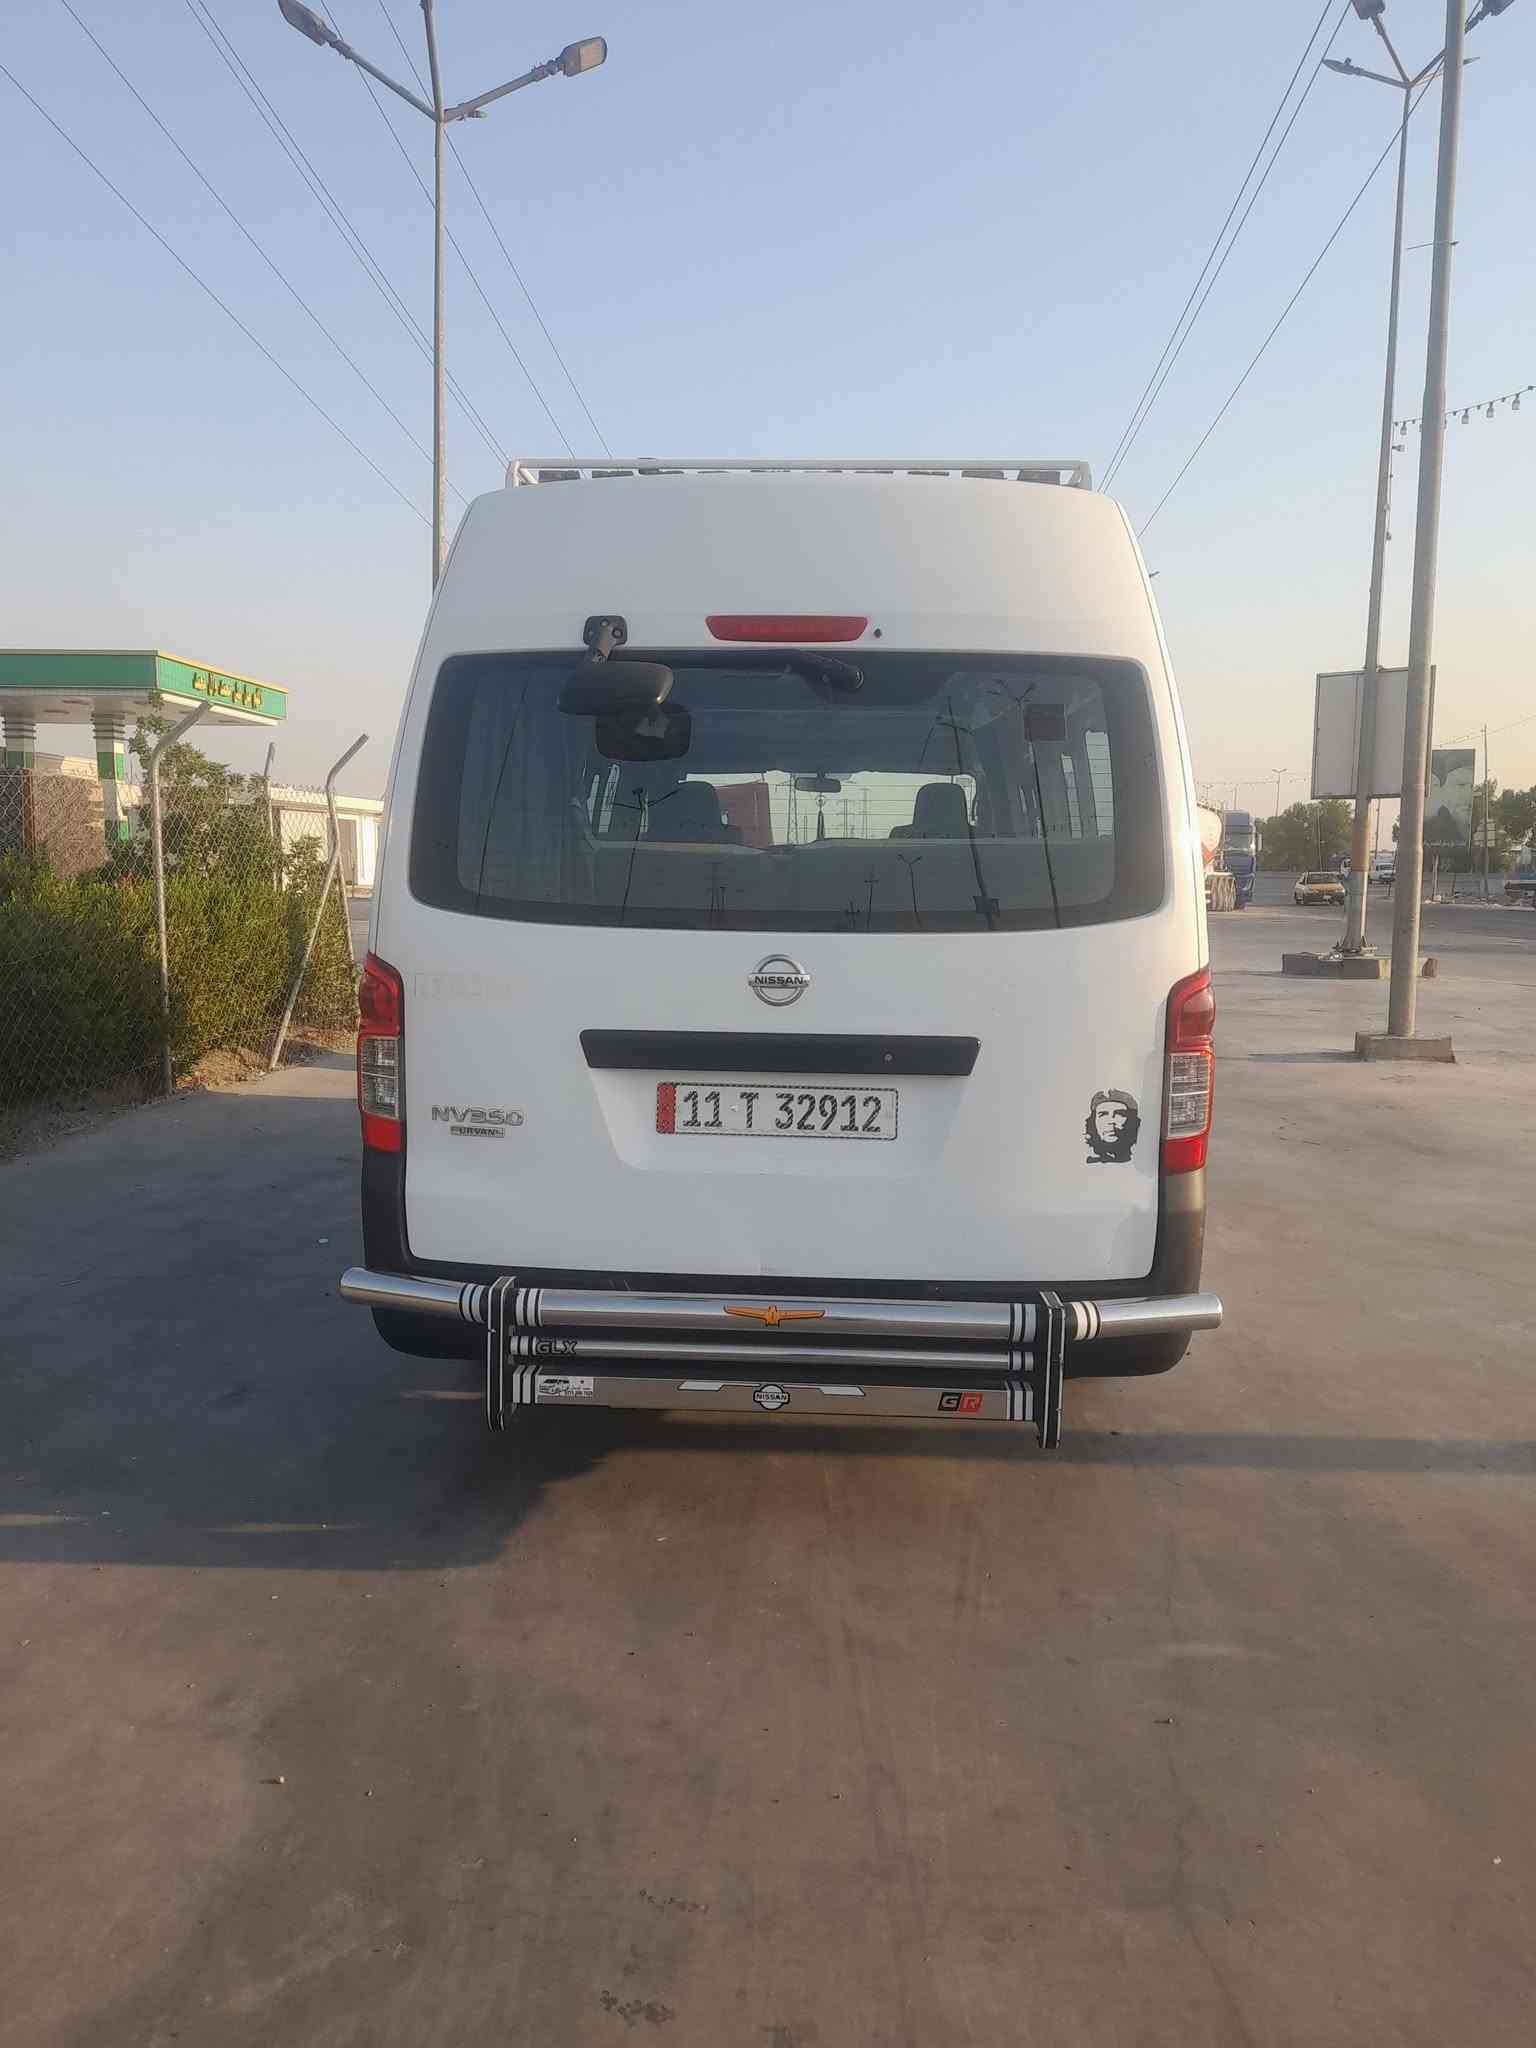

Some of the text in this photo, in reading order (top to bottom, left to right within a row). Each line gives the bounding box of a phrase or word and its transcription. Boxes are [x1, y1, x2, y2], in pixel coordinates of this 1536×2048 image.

[754, 975, 803, 985] NISSAN
[431, 1104, 525, 1126] NV350
[682, 1090, 882, 1132] 11 T 32912
[536, 1341, 577, 1355] GLX
[755, 1392, 789, 1402] NISSAN
[941, 1394, 981, 1410] GR
